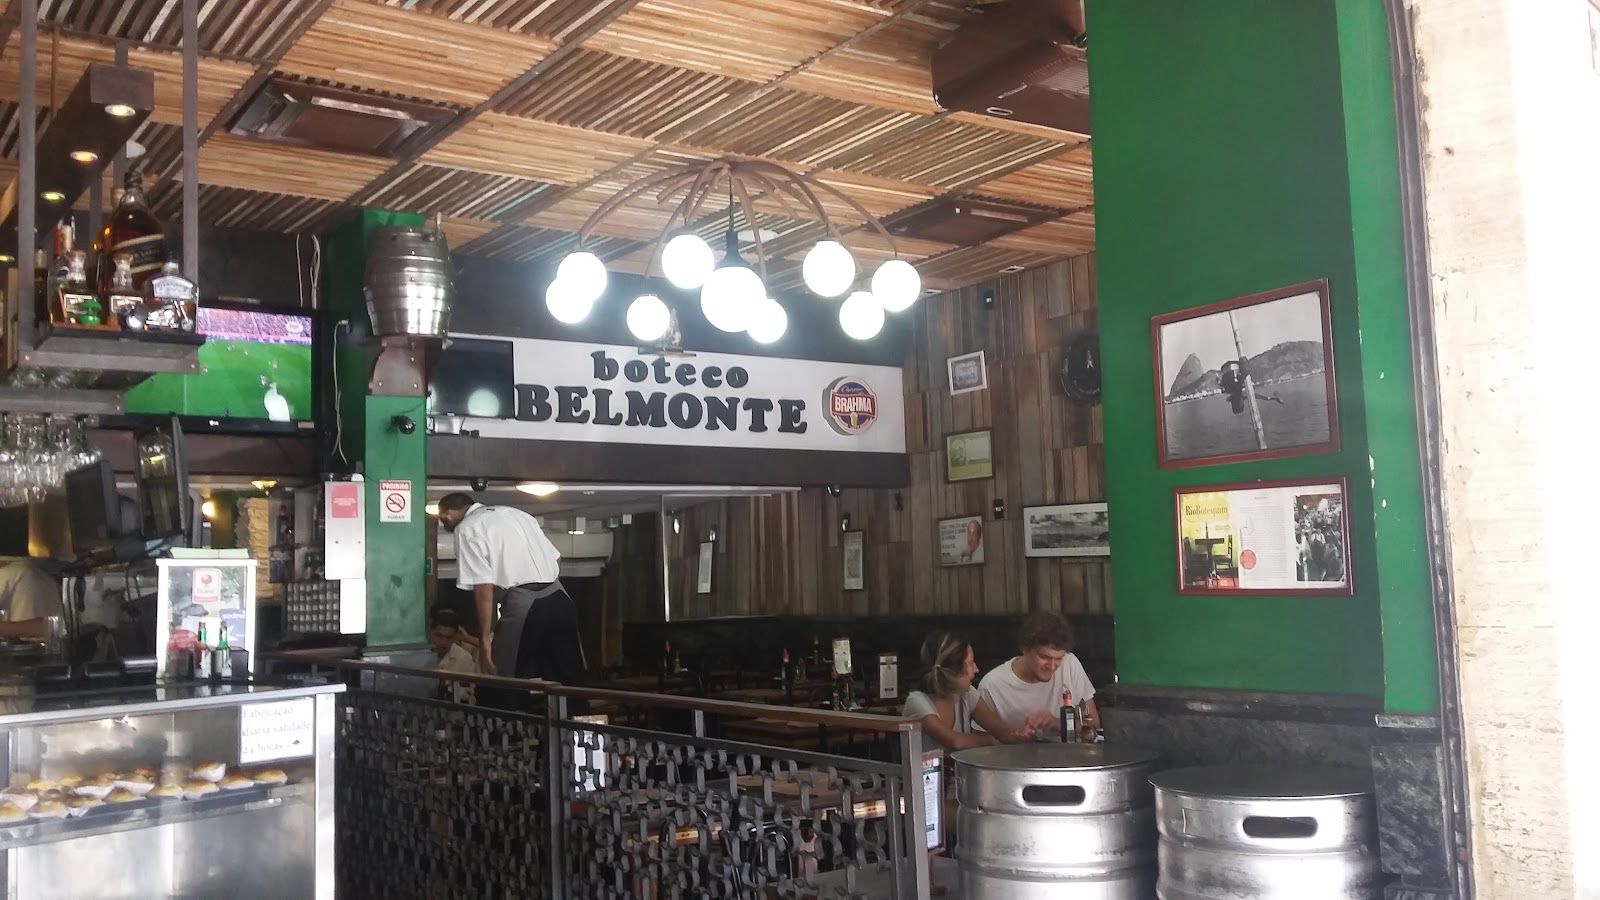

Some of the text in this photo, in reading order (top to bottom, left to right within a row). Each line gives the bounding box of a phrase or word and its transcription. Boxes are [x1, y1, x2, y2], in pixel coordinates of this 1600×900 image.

[590, 350, 749, 388] boteco
[514, 383, 808, 434] BELMONTE
[834, 396, 873, 413] BRAHMA
